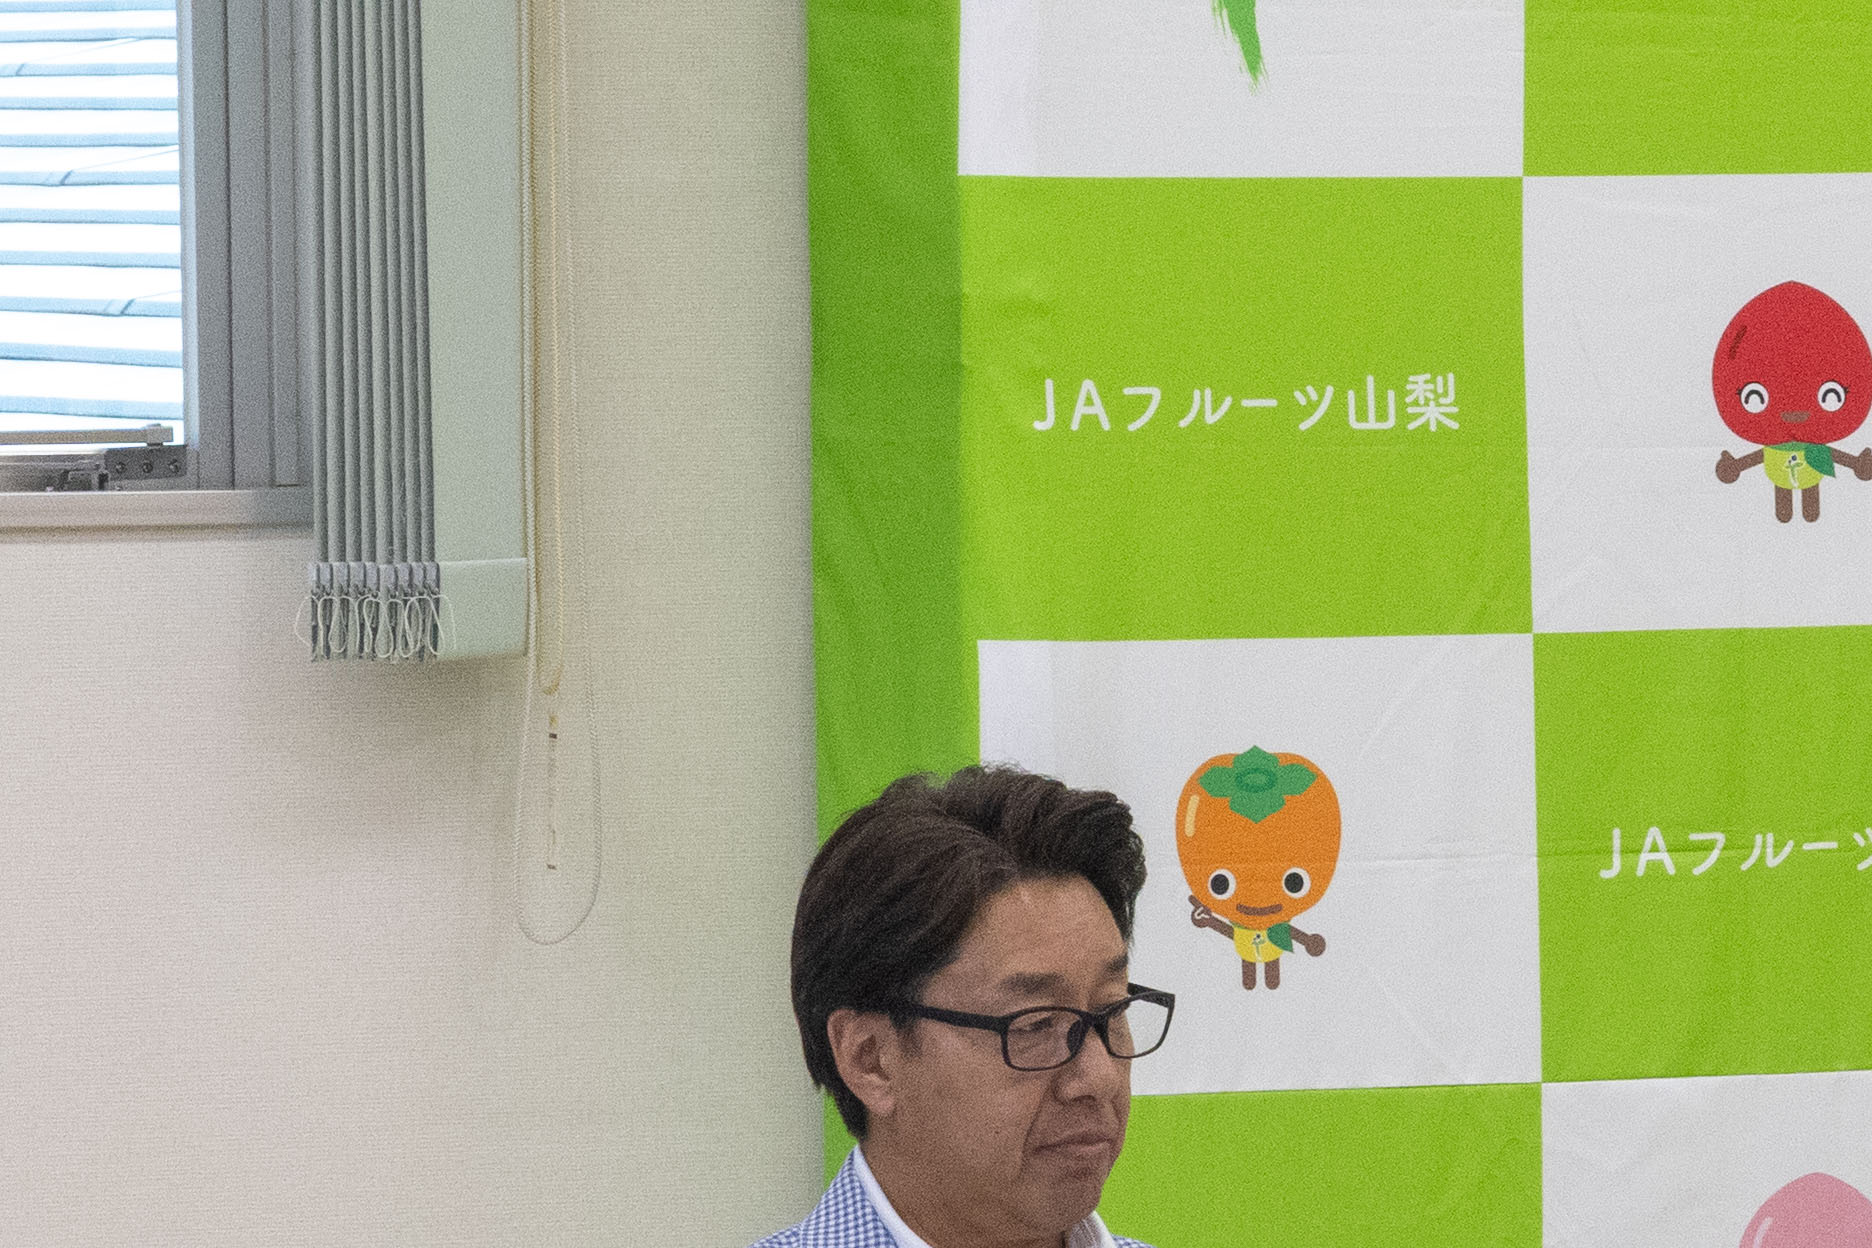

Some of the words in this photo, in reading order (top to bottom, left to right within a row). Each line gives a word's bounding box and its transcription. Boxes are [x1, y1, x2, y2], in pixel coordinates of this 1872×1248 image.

[1031, 372, 1461, 433] JAフルーツ山梨
